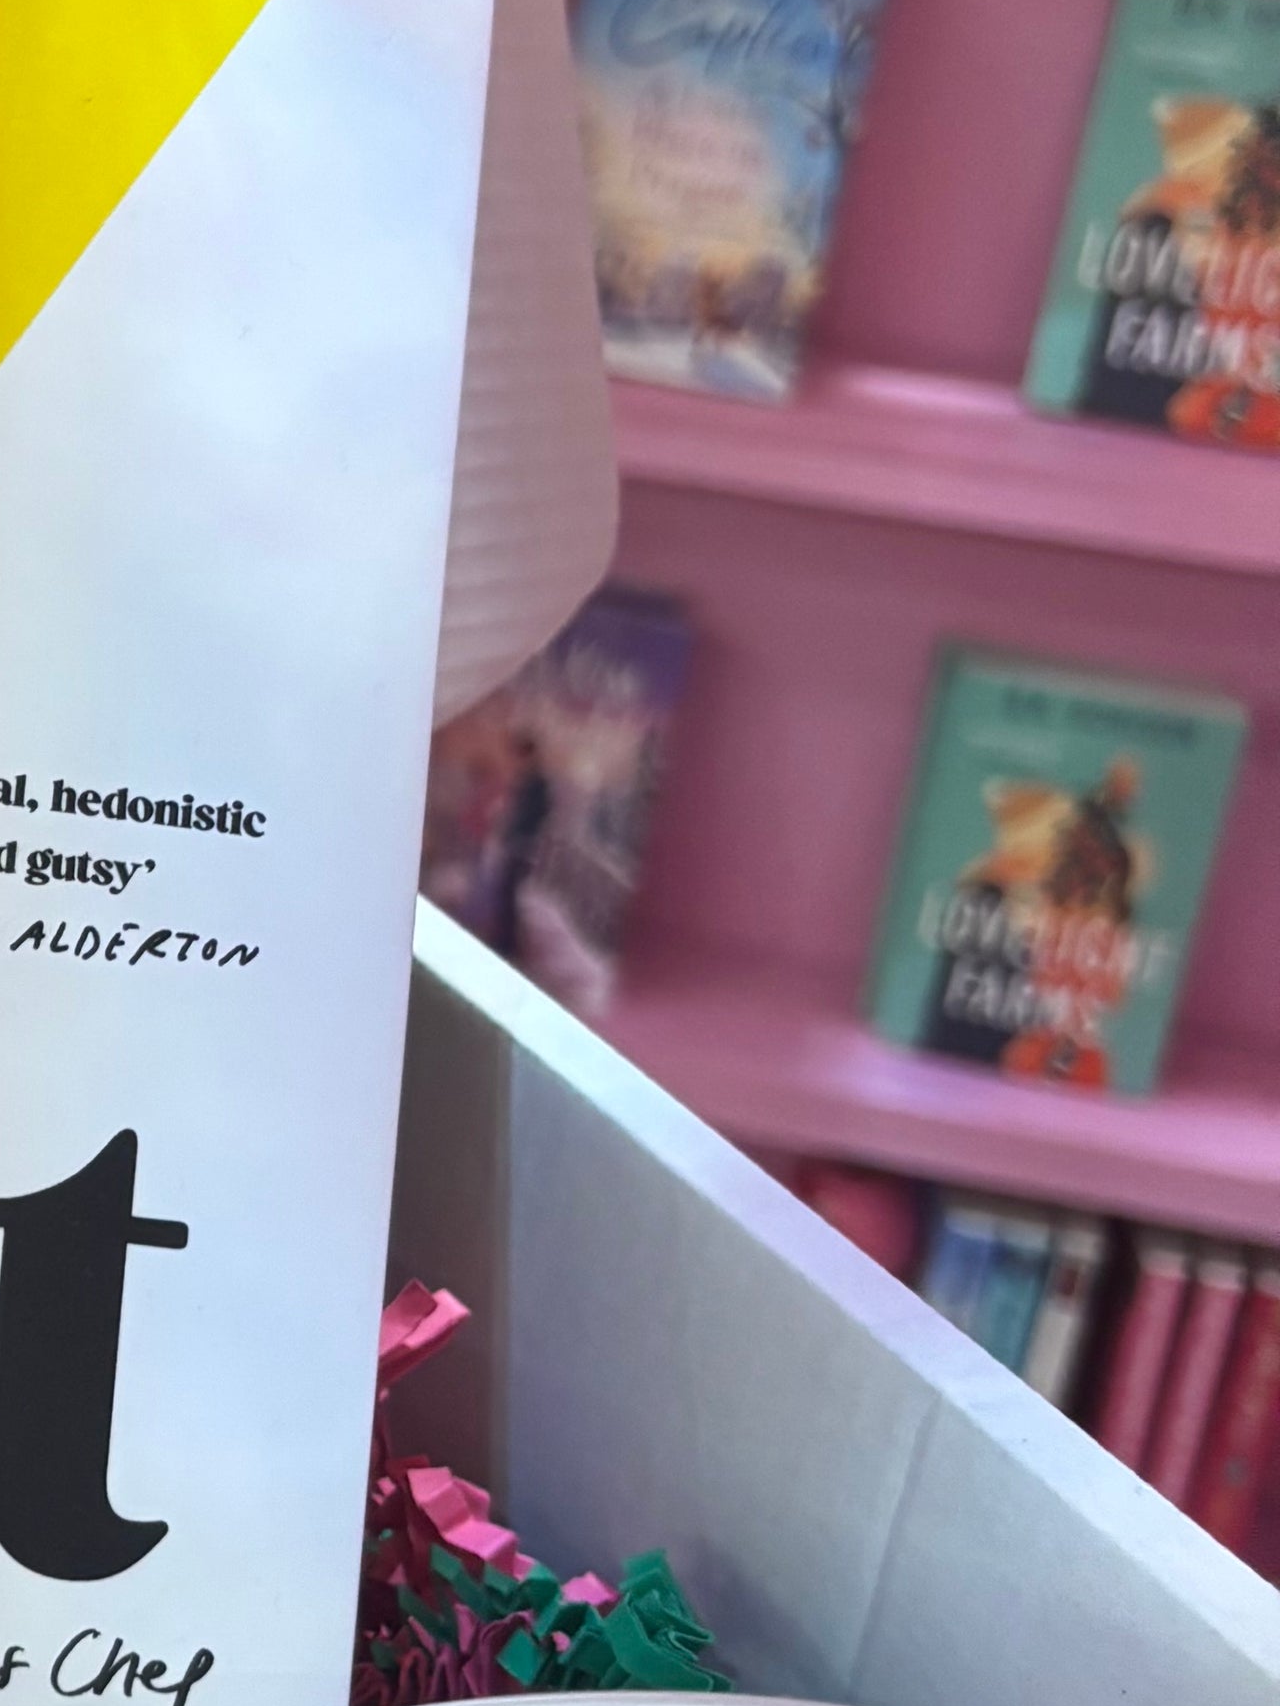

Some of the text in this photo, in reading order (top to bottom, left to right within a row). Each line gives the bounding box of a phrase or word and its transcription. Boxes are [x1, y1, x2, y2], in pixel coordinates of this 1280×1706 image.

[50, 780, 267, 837] hedonistic
[24, 849, 156, 895] gutsy’
[10, 920, 260, 966] ALDERTON
